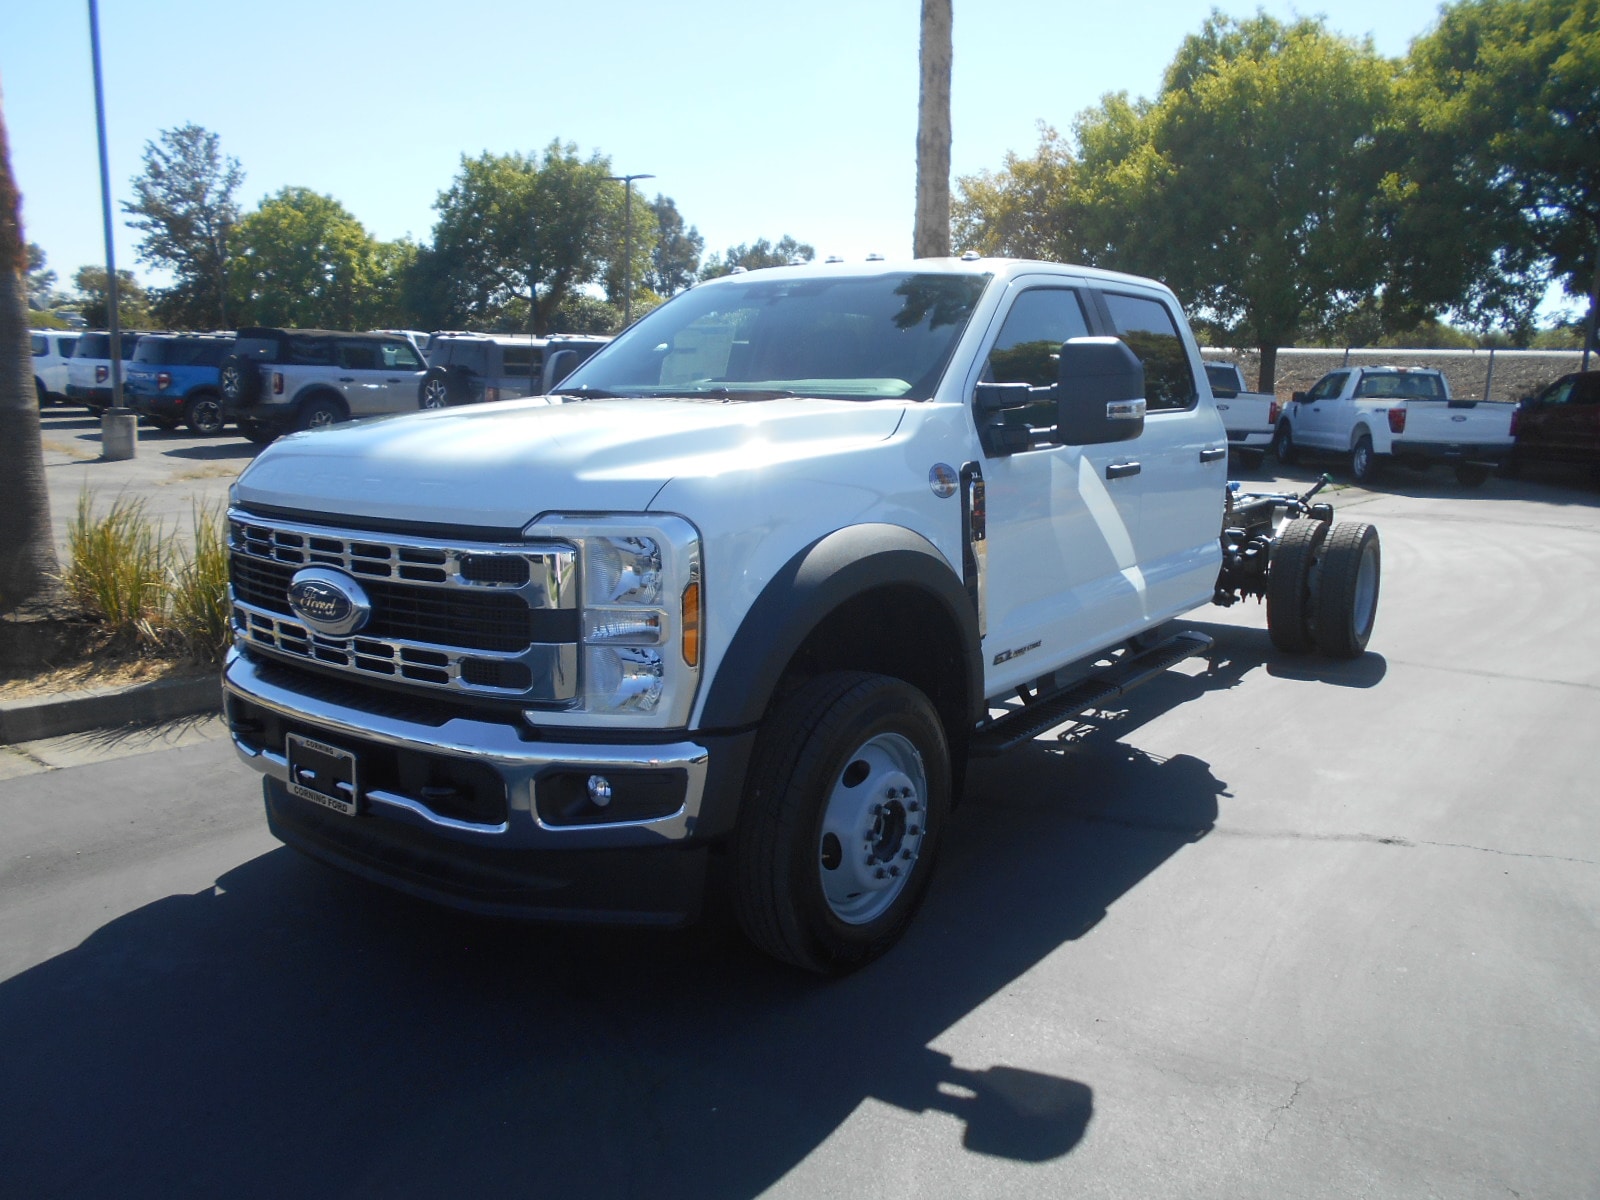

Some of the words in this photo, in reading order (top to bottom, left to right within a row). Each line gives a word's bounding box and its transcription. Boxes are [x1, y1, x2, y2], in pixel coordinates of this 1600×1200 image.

[300, 586, 336, 610] Ford
[306, 740, 334, 755] CORNING
[294, 785, 327, 805] CORNING
[328, 800, 349, 813] FORD
